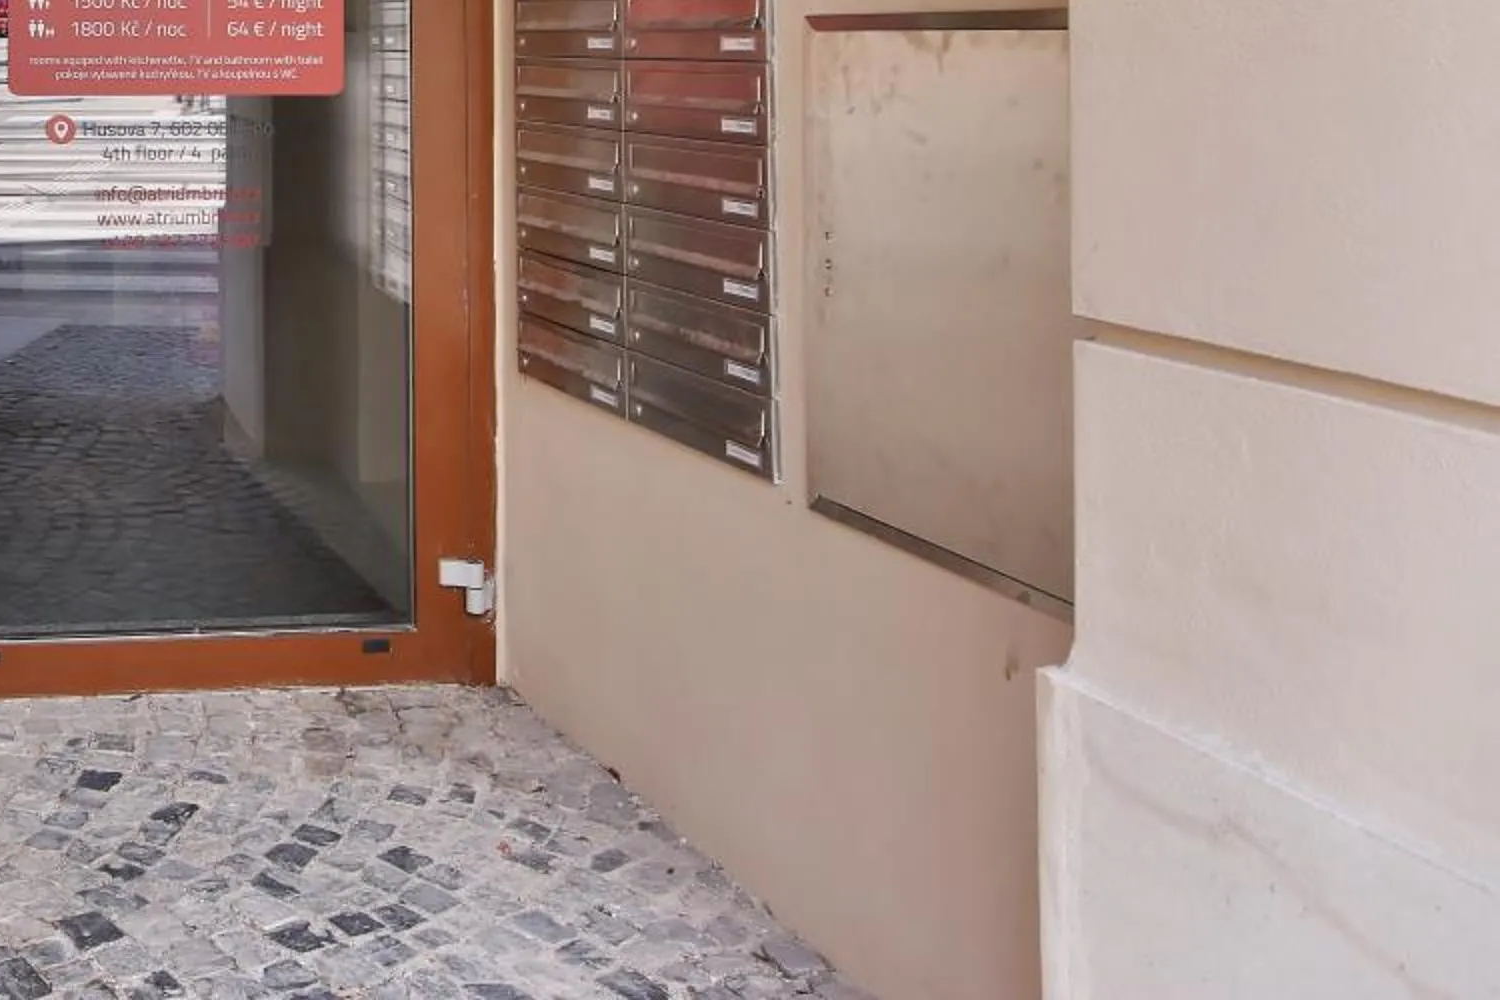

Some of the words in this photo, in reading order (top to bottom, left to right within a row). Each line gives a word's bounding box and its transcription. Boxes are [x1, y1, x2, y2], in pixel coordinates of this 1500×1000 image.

[71, 21, 114, 37] 1800
[121, 20, 140, 37] Kč
[143, 21, 153, 37] /
[156, 24, 188, 37] noc
[227, 21, 248, 37] 64
[253, 22, 265, 37] €
[269, 22, 277, 37] /
[281, 21, 324, 41] night
[83, 121, 145, 137] Husova
[102, 145, 131, 161] 4th
[135, 145, 175, 161] floor
